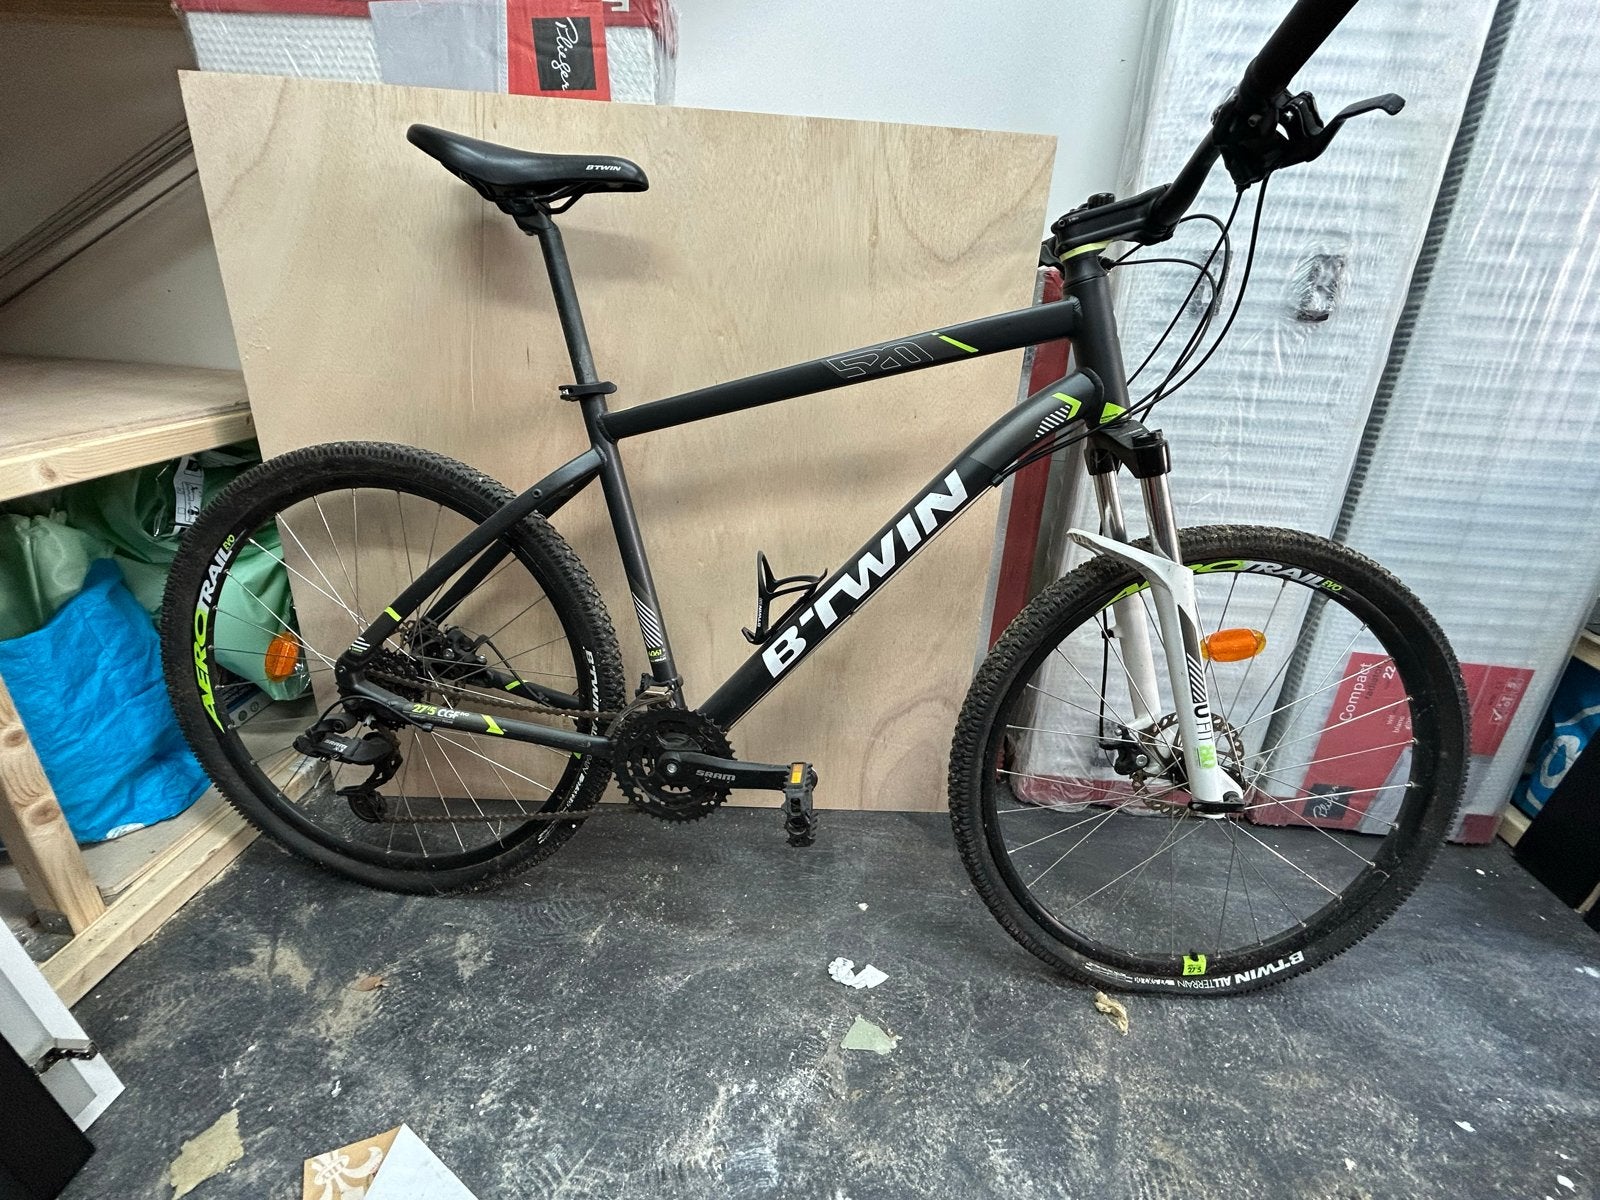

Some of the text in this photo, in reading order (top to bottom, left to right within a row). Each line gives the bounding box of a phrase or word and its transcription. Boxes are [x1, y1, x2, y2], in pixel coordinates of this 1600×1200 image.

[551, 17, 579, 91] Plieger
[222, 533, 236, 551] EVO
[1322, 578, 1342, 592] EVO
[695, 769, 736, 781] SRAM
